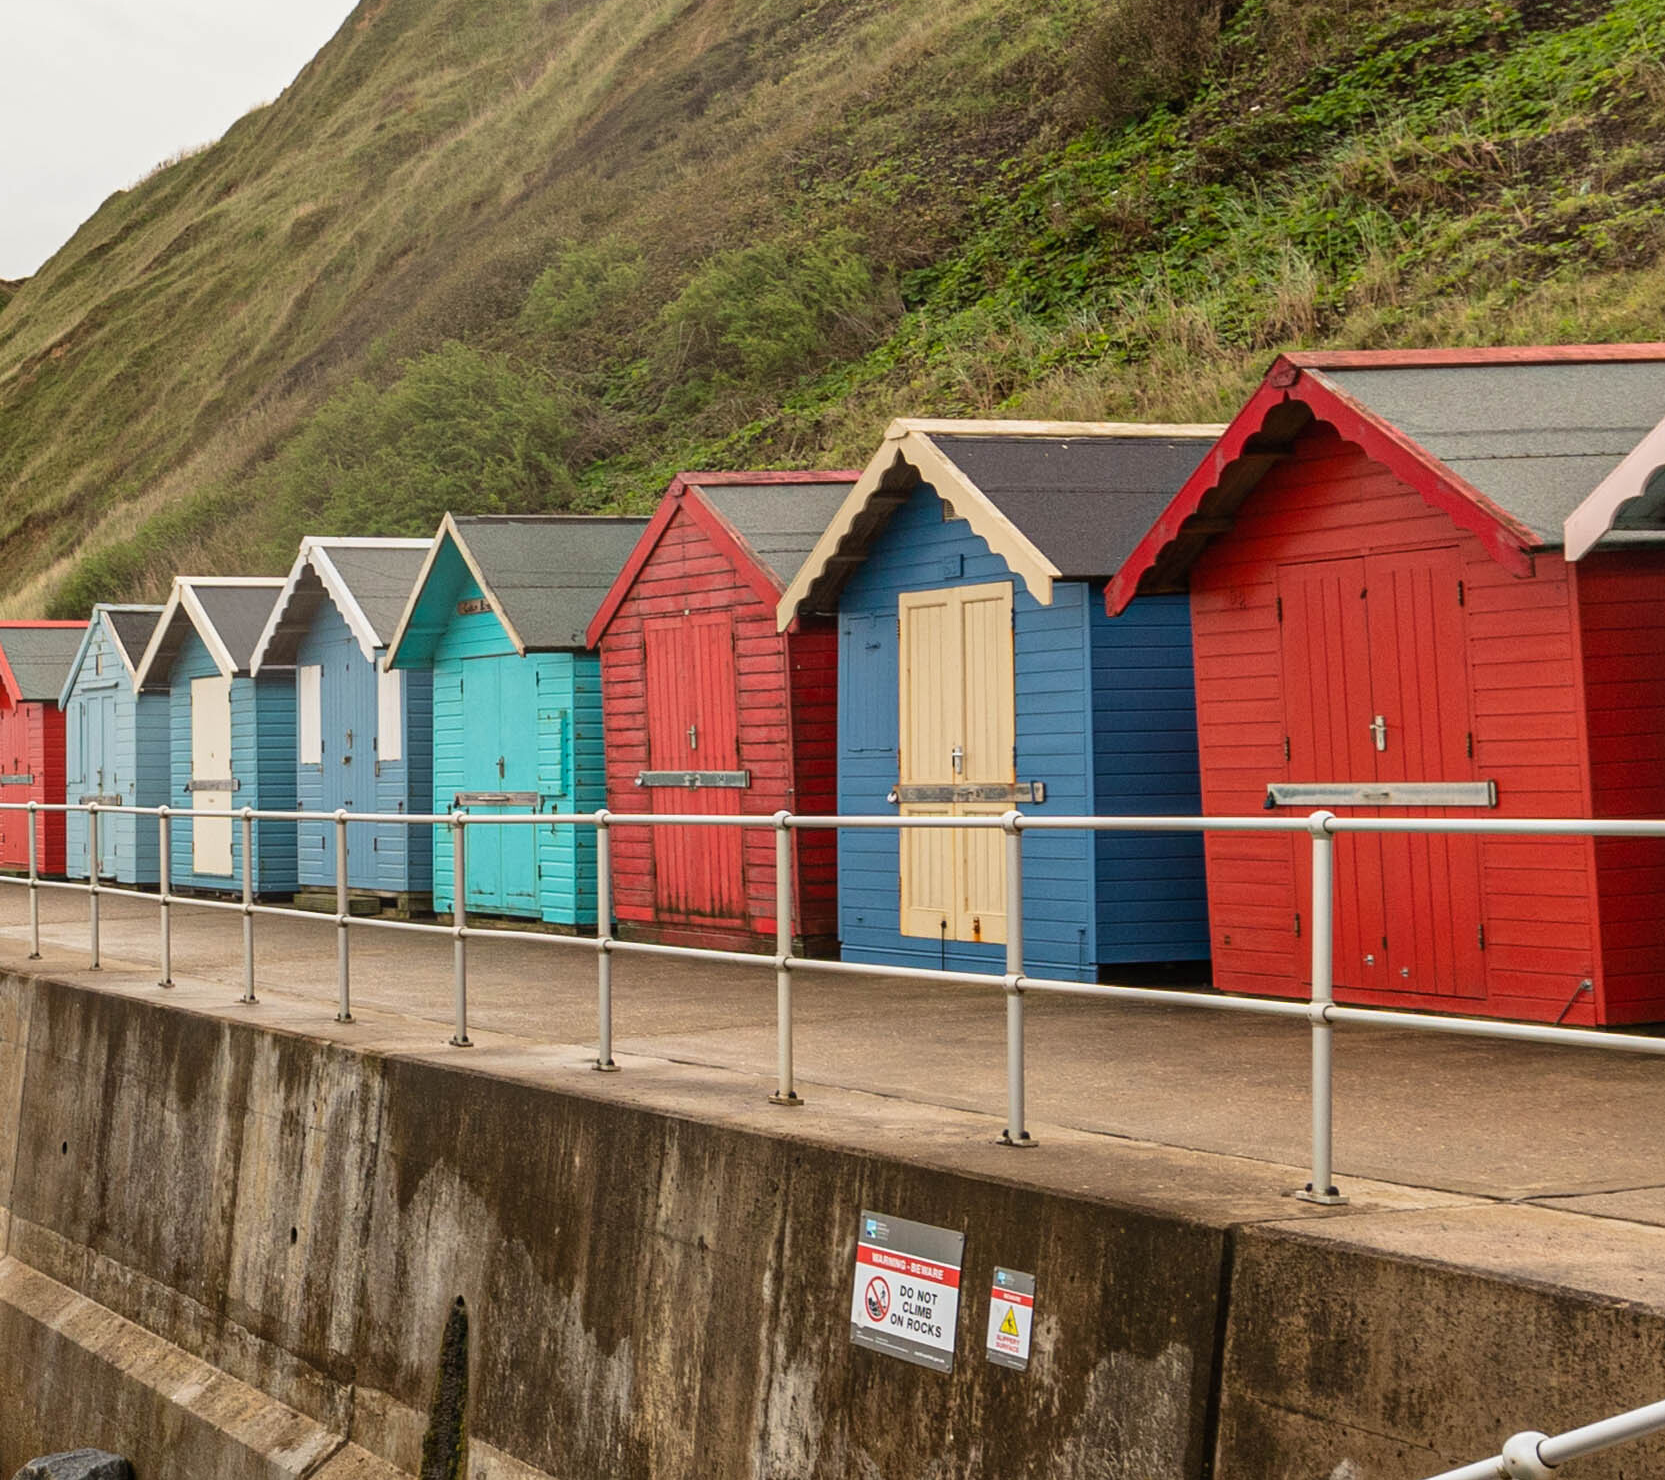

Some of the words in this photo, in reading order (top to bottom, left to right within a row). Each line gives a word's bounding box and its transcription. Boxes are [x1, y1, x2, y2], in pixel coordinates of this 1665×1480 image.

[872, 1252, 906, 1271] WARNING
[910, 1263, 944, 1280] BEWARE
[900, 1285, 914, 1299] DO
[917, 1289, 938, 1305] NOT
[903, 1301, 932, 1319] CLIMB
[890, 1313, 904, 1327] ON
[907, 1318, 942, 1338] ROCKS
